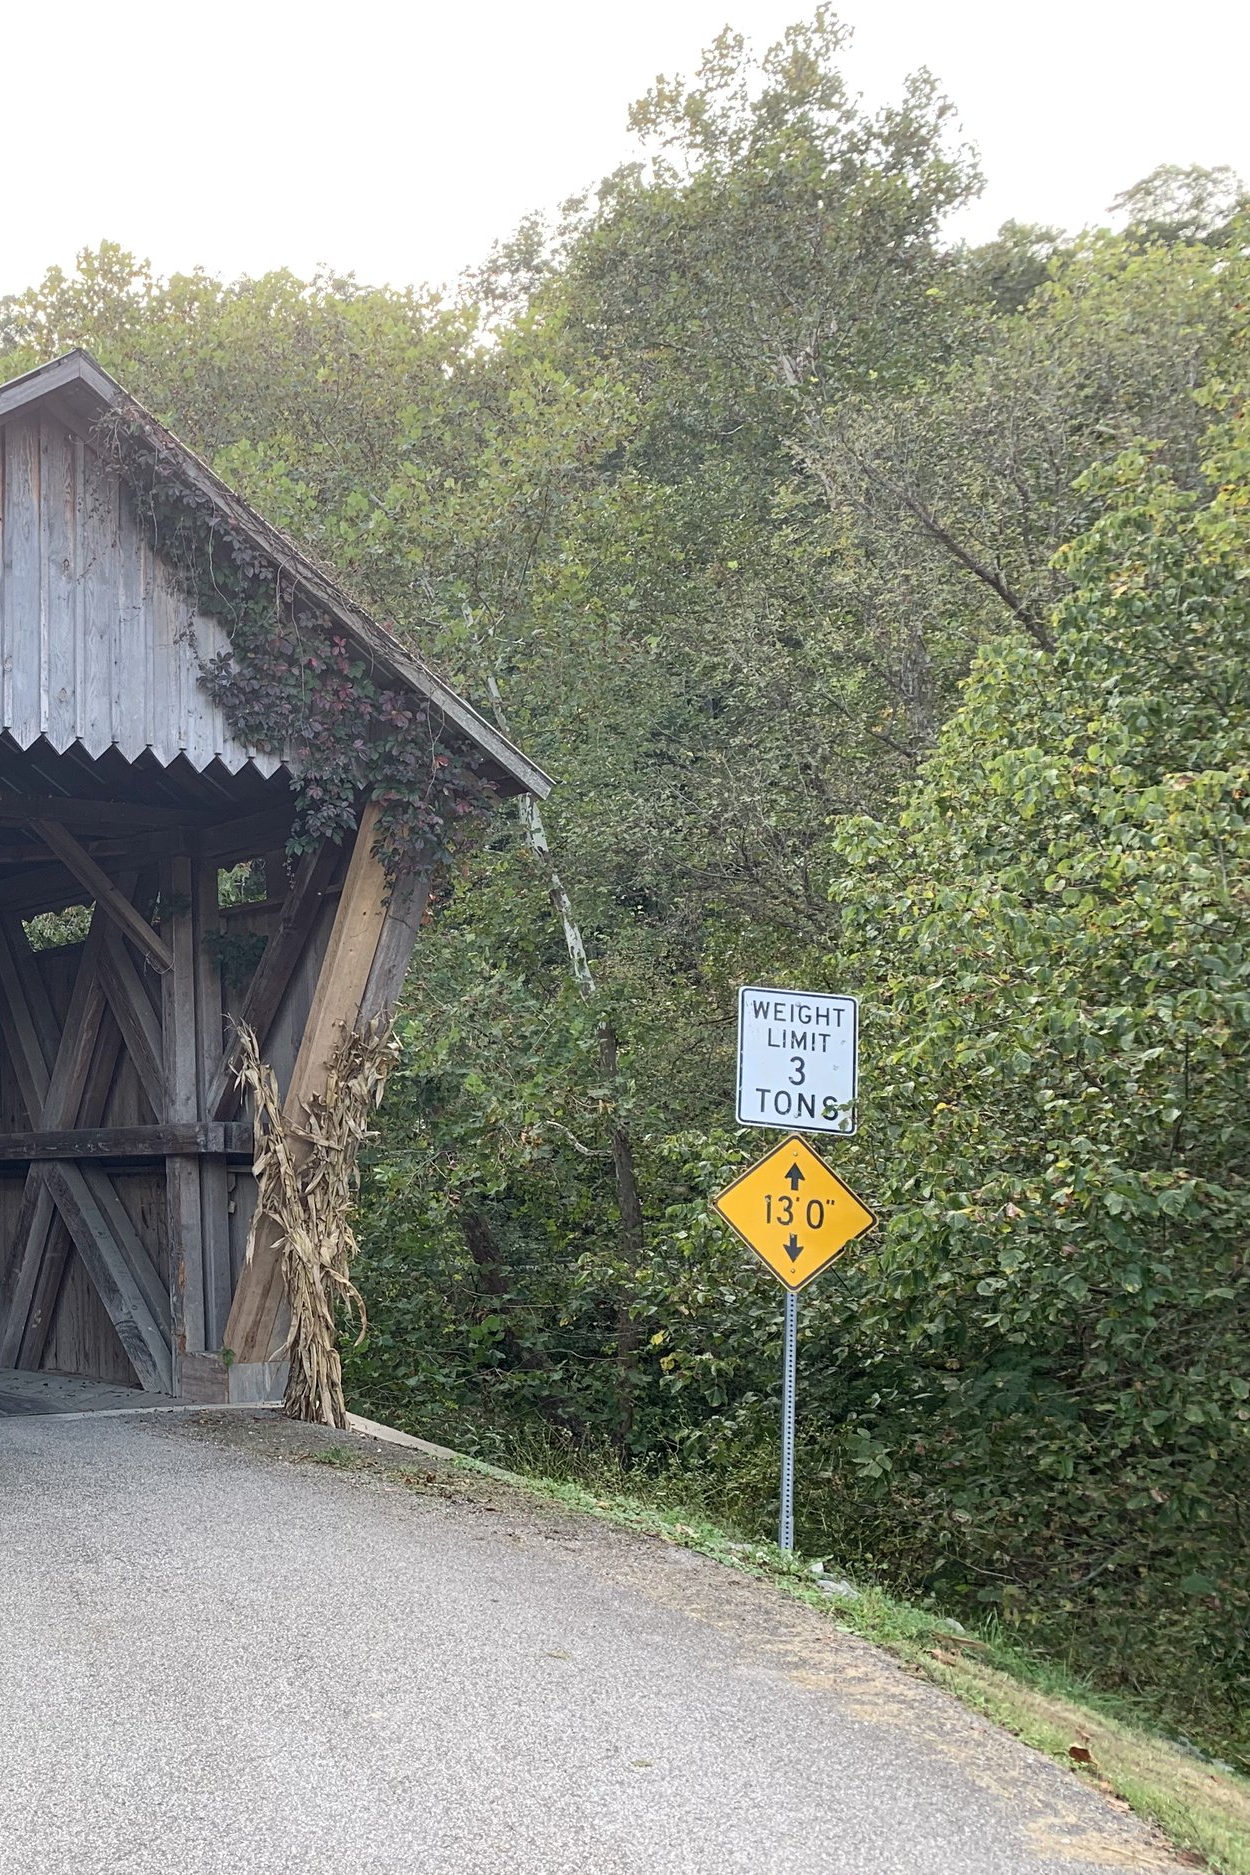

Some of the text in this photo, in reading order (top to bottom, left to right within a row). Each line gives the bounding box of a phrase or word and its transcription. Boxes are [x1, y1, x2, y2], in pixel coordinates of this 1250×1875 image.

[753, 1000, 845, 1027] WEIGHT
[768, 1028, 831, 1052] LIMIT
[788, 1056, 806, 1086] 3
[755, 1088, 839, 1121] TONS
